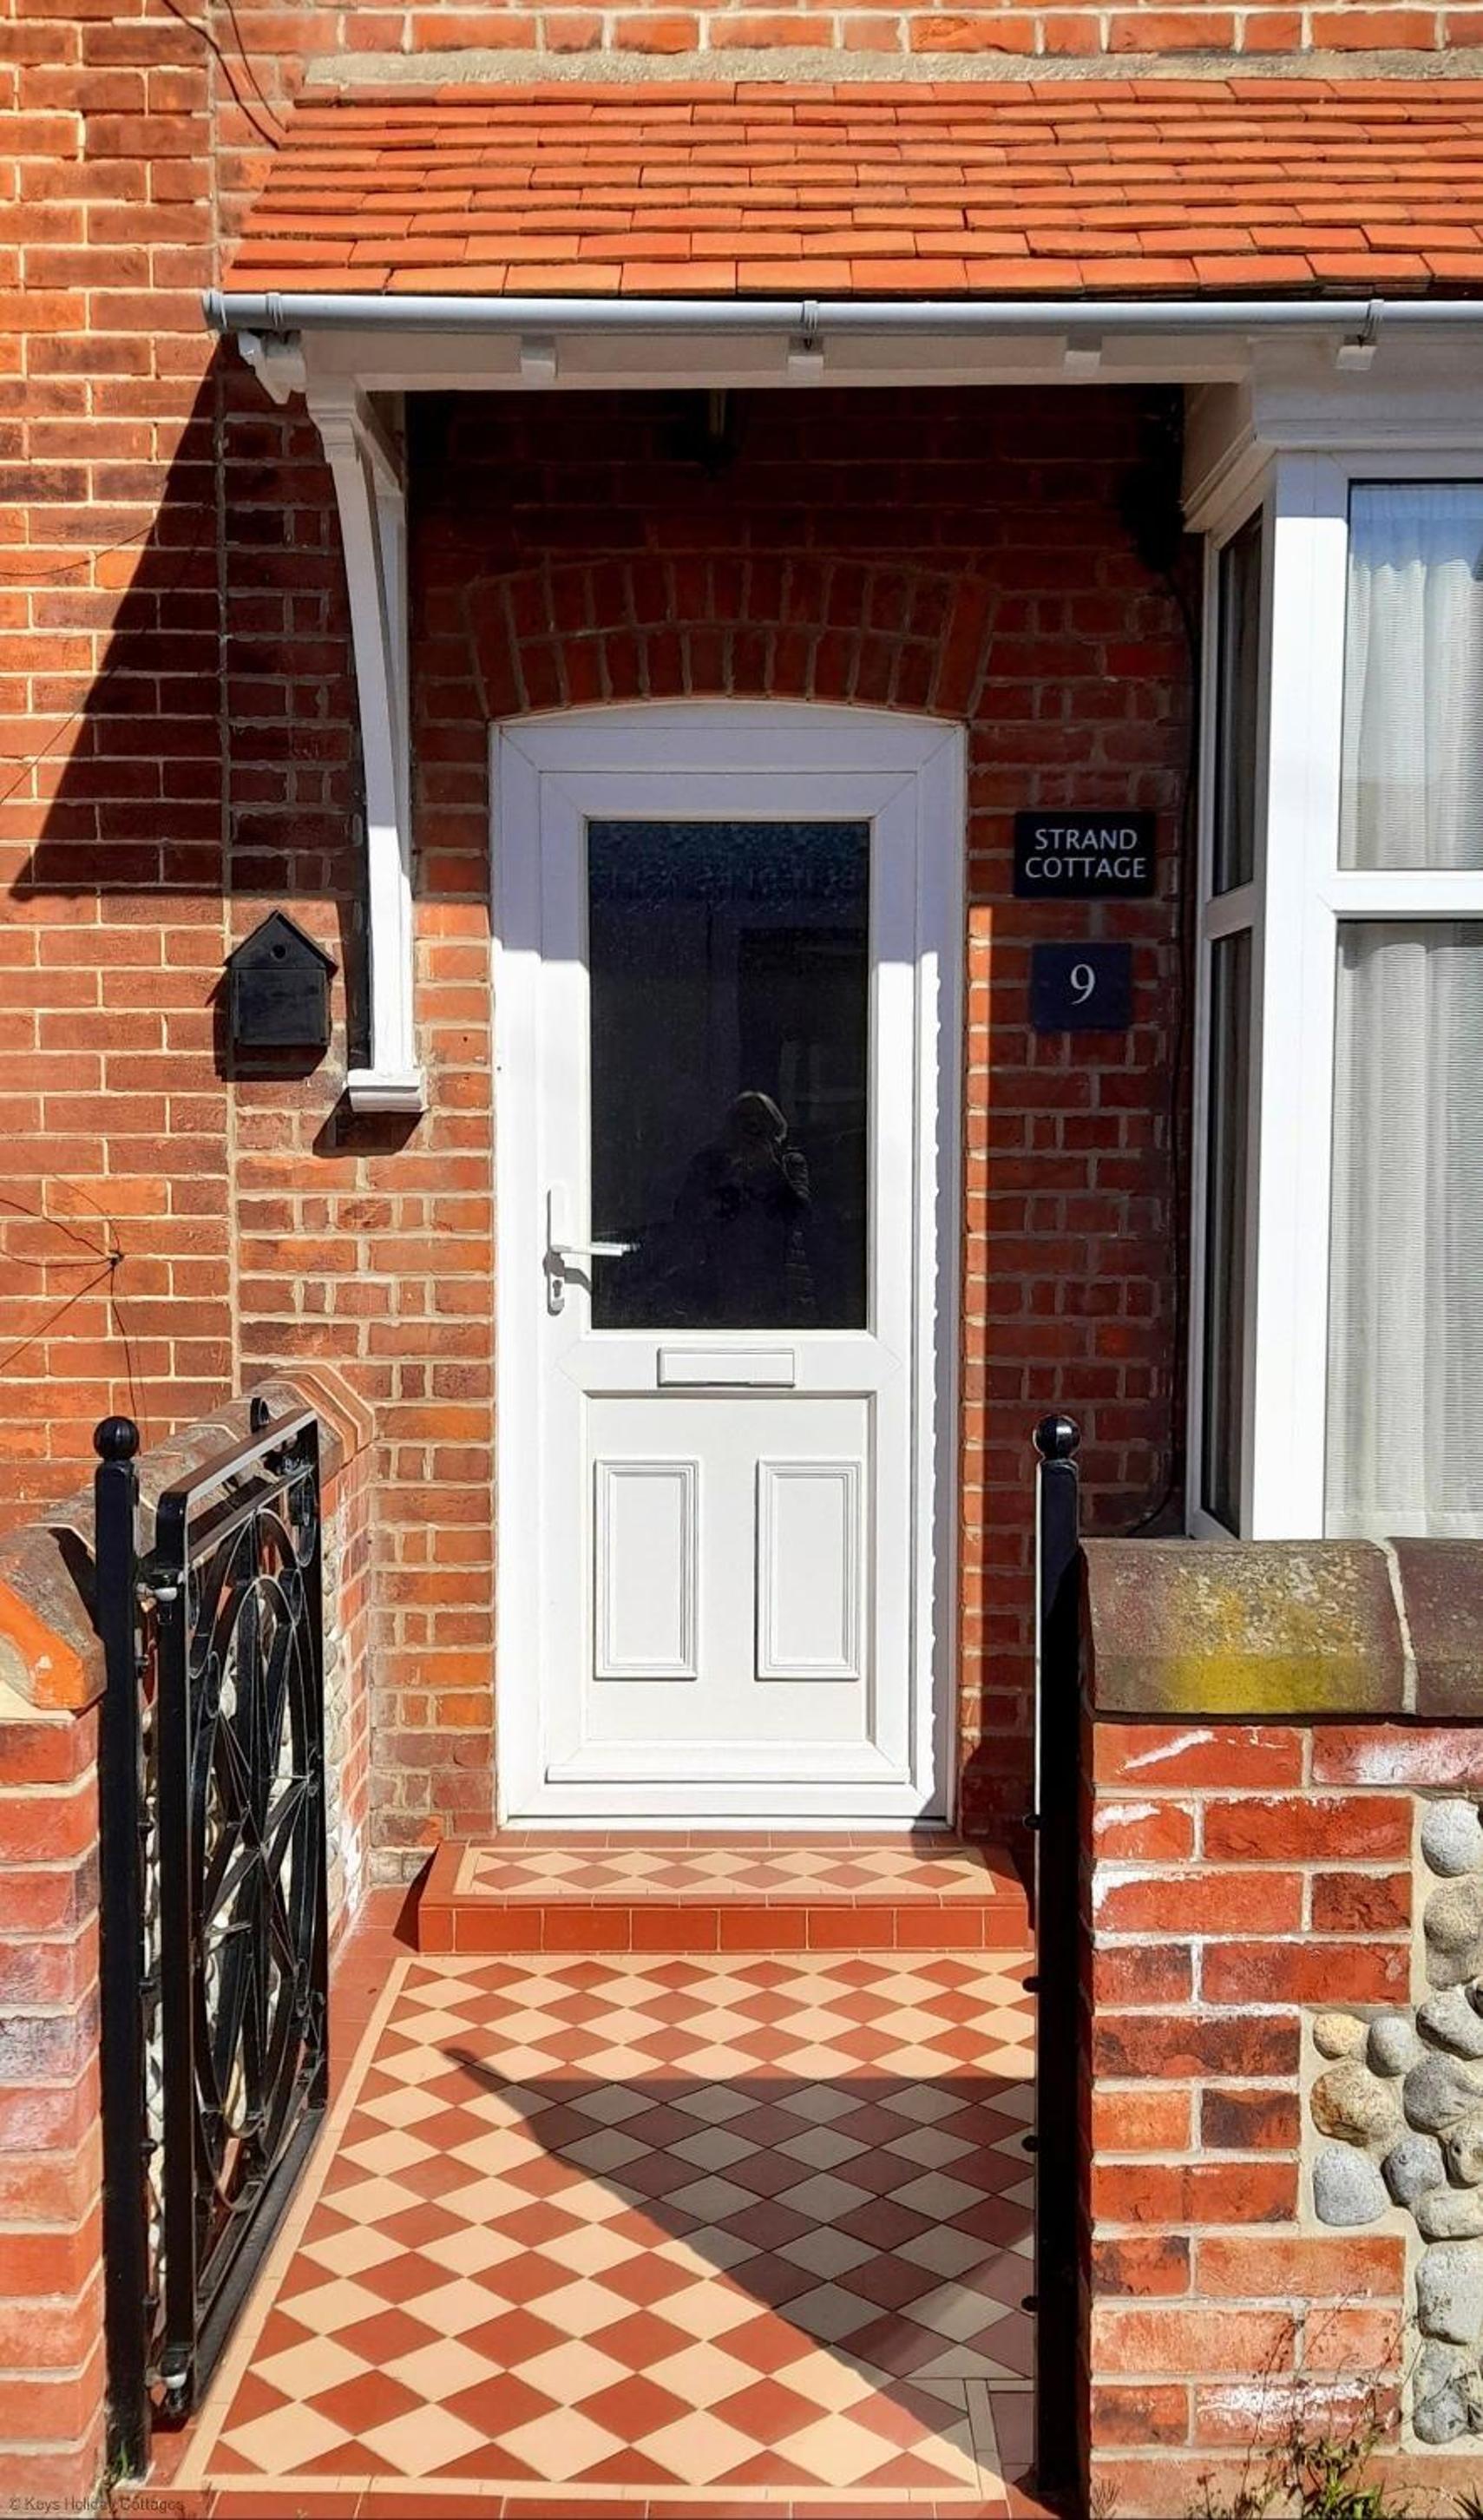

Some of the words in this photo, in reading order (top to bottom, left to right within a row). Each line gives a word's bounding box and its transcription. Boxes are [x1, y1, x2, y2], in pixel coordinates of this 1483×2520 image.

[1034, 829, 1138, 850] STRAND
[1025, 856, 1147, 879] COTTAGE
[1069, 963, 1097, 1005] 9
